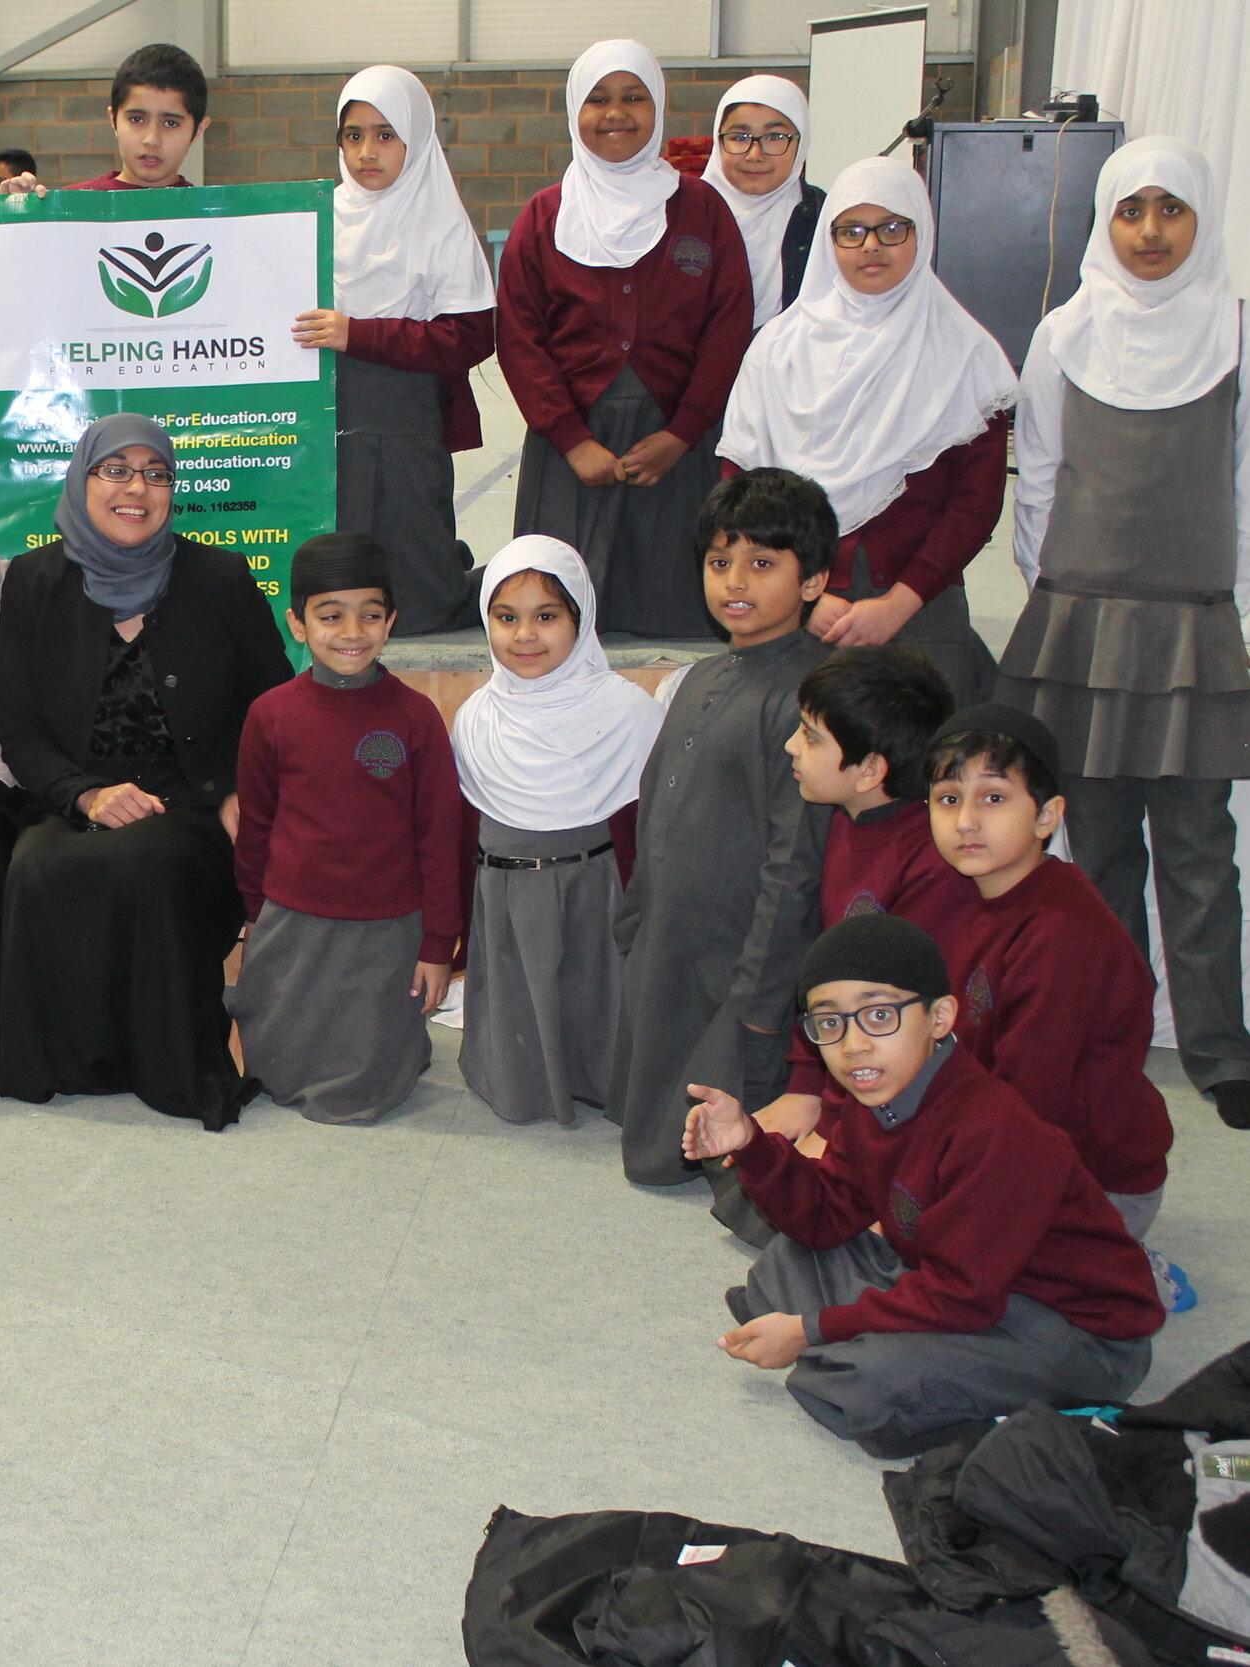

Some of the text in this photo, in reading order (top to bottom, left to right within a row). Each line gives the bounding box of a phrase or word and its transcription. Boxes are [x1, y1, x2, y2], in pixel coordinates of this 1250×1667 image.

[50, 336, 265, 363] HELPING HANDS
[118, 361, 265, 375] EDUCATION
[16, 441, 78, 454] www.fa
[169, 433, 298, 450] HHForEducation
[173, 478, 230, 493] 75 0430
[187, 503, 207, 513] No.
[211, 501, 257, 512] 1162358
[182, 528, 288, 546] OOLS WITH
